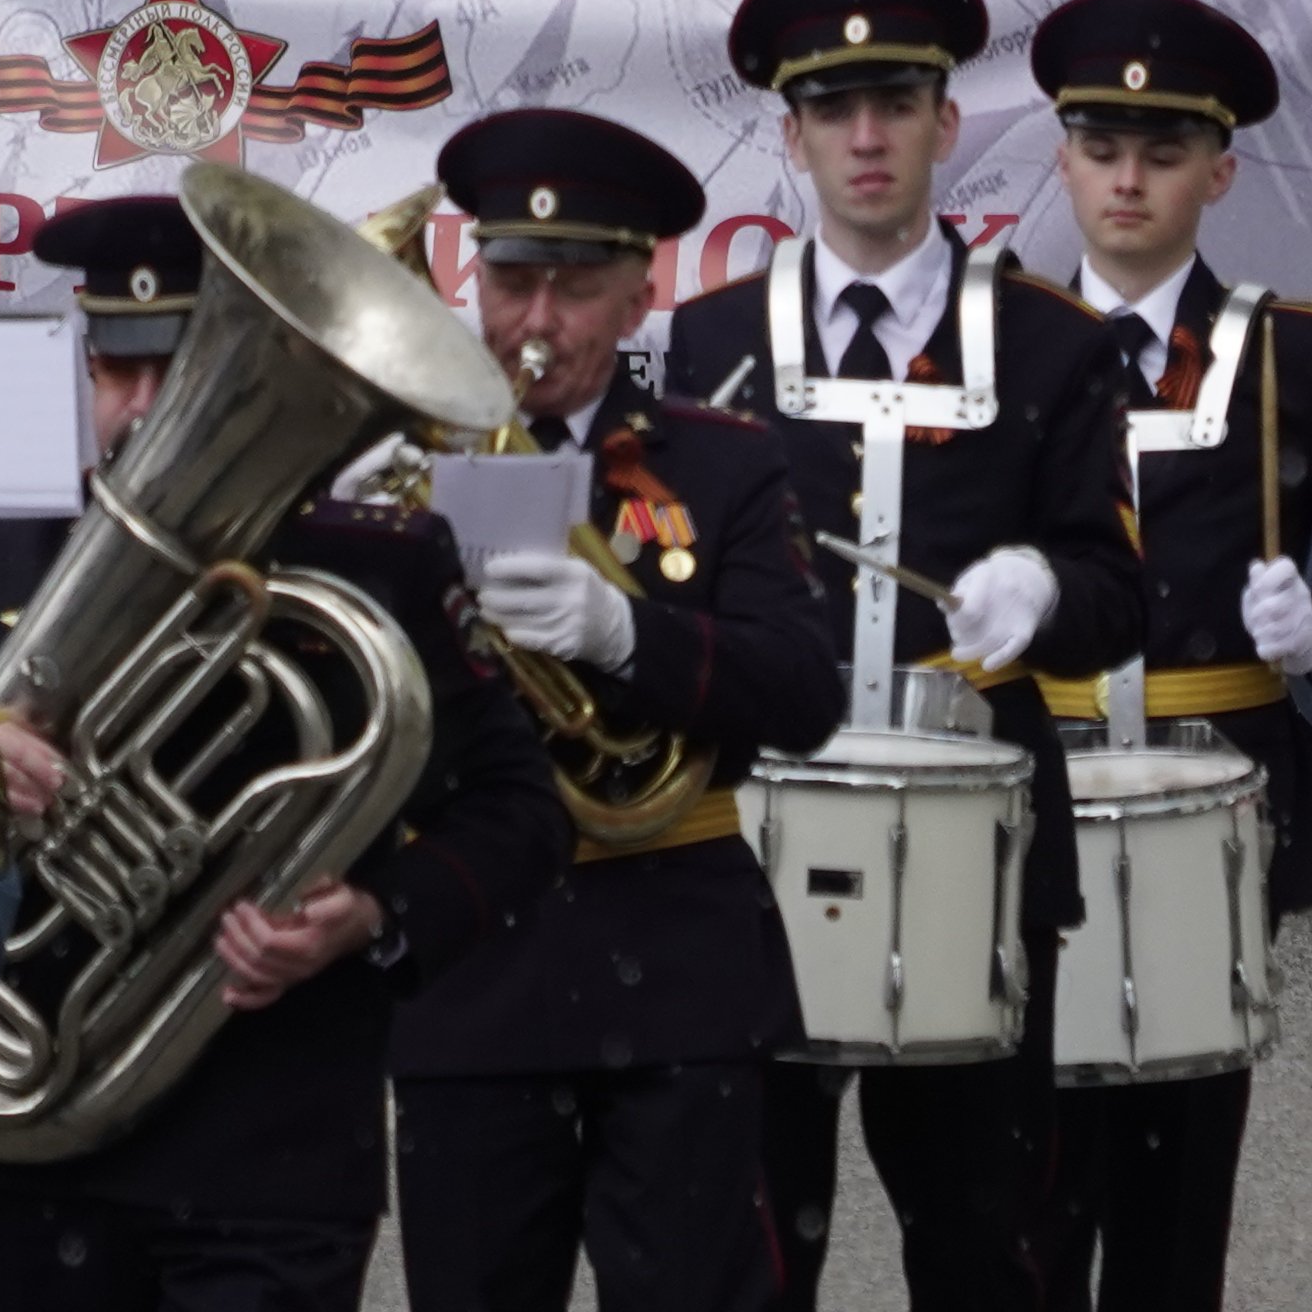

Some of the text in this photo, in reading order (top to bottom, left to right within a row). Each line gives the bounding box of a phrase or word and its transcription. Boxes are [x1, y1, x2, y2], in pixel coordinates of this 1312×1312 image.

[179, 5, 224, 35] ПОЛК
[100, 3, 172, 104] БЕССМЕРТНЫЙ
[223, 32, 250, 107] РОССИИ
[694, 73, 746, 106] ТУЛ
